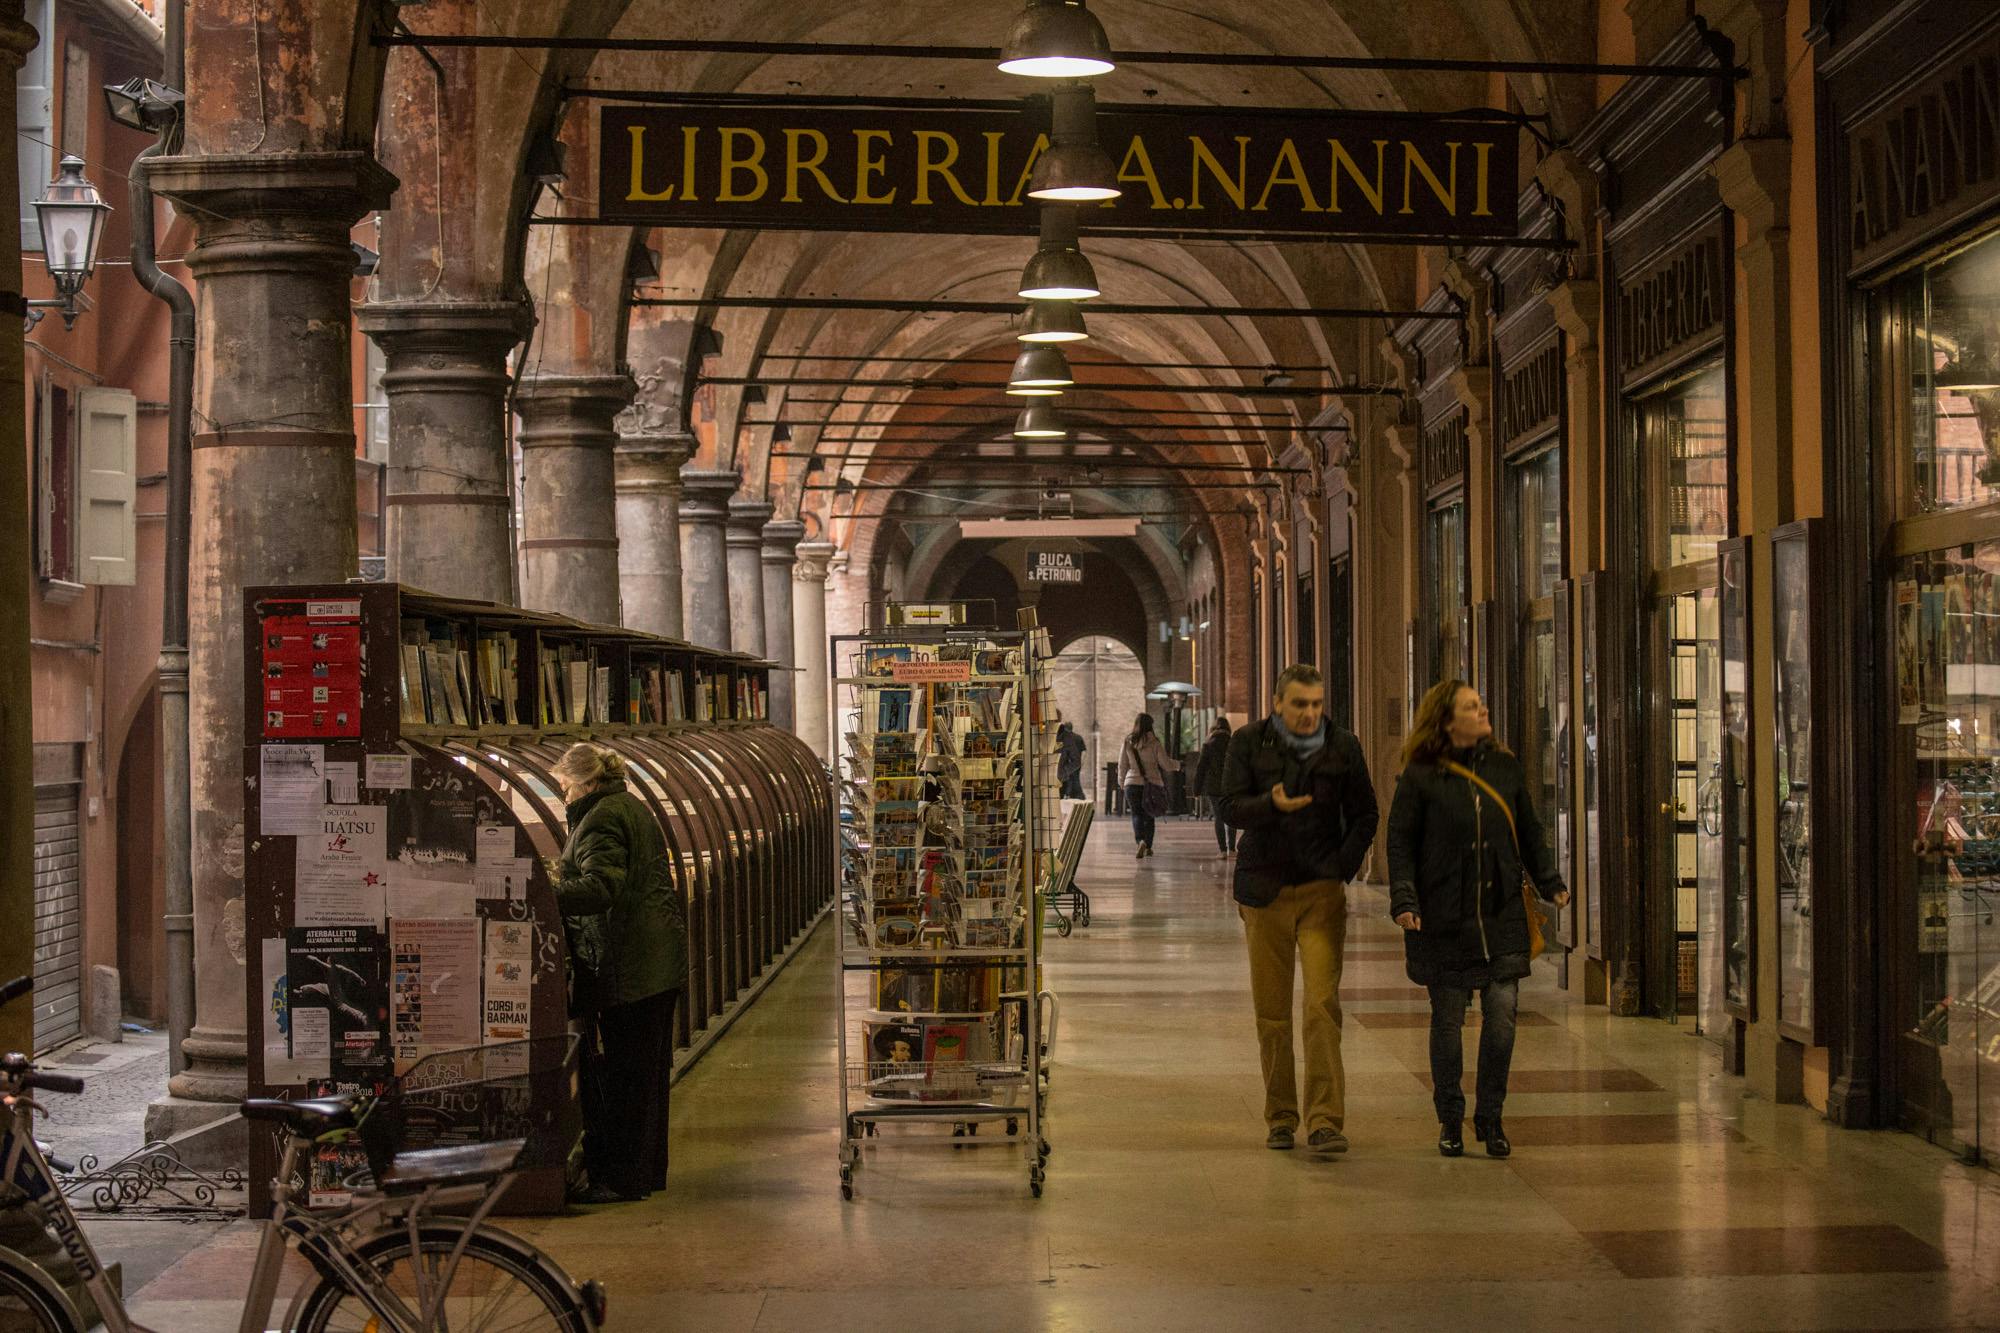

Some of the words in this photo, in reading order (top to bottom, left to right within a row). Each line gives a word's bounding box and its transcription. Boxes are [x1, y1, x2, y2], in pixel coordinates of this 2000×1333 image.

[1100, 134, 1494, 216] A.NANNI
[1616, 238, 1714, 374] LIBRERIA
[1039, 553, 1072, 566] BUCA
[327, 808, 357, 816] SCUOLA
[306, 930, 357, 938] ATERBALLETTO
[487, 1000, 513, 1012] CORSI
[487, 1012, 528, 1024] BARMAN
